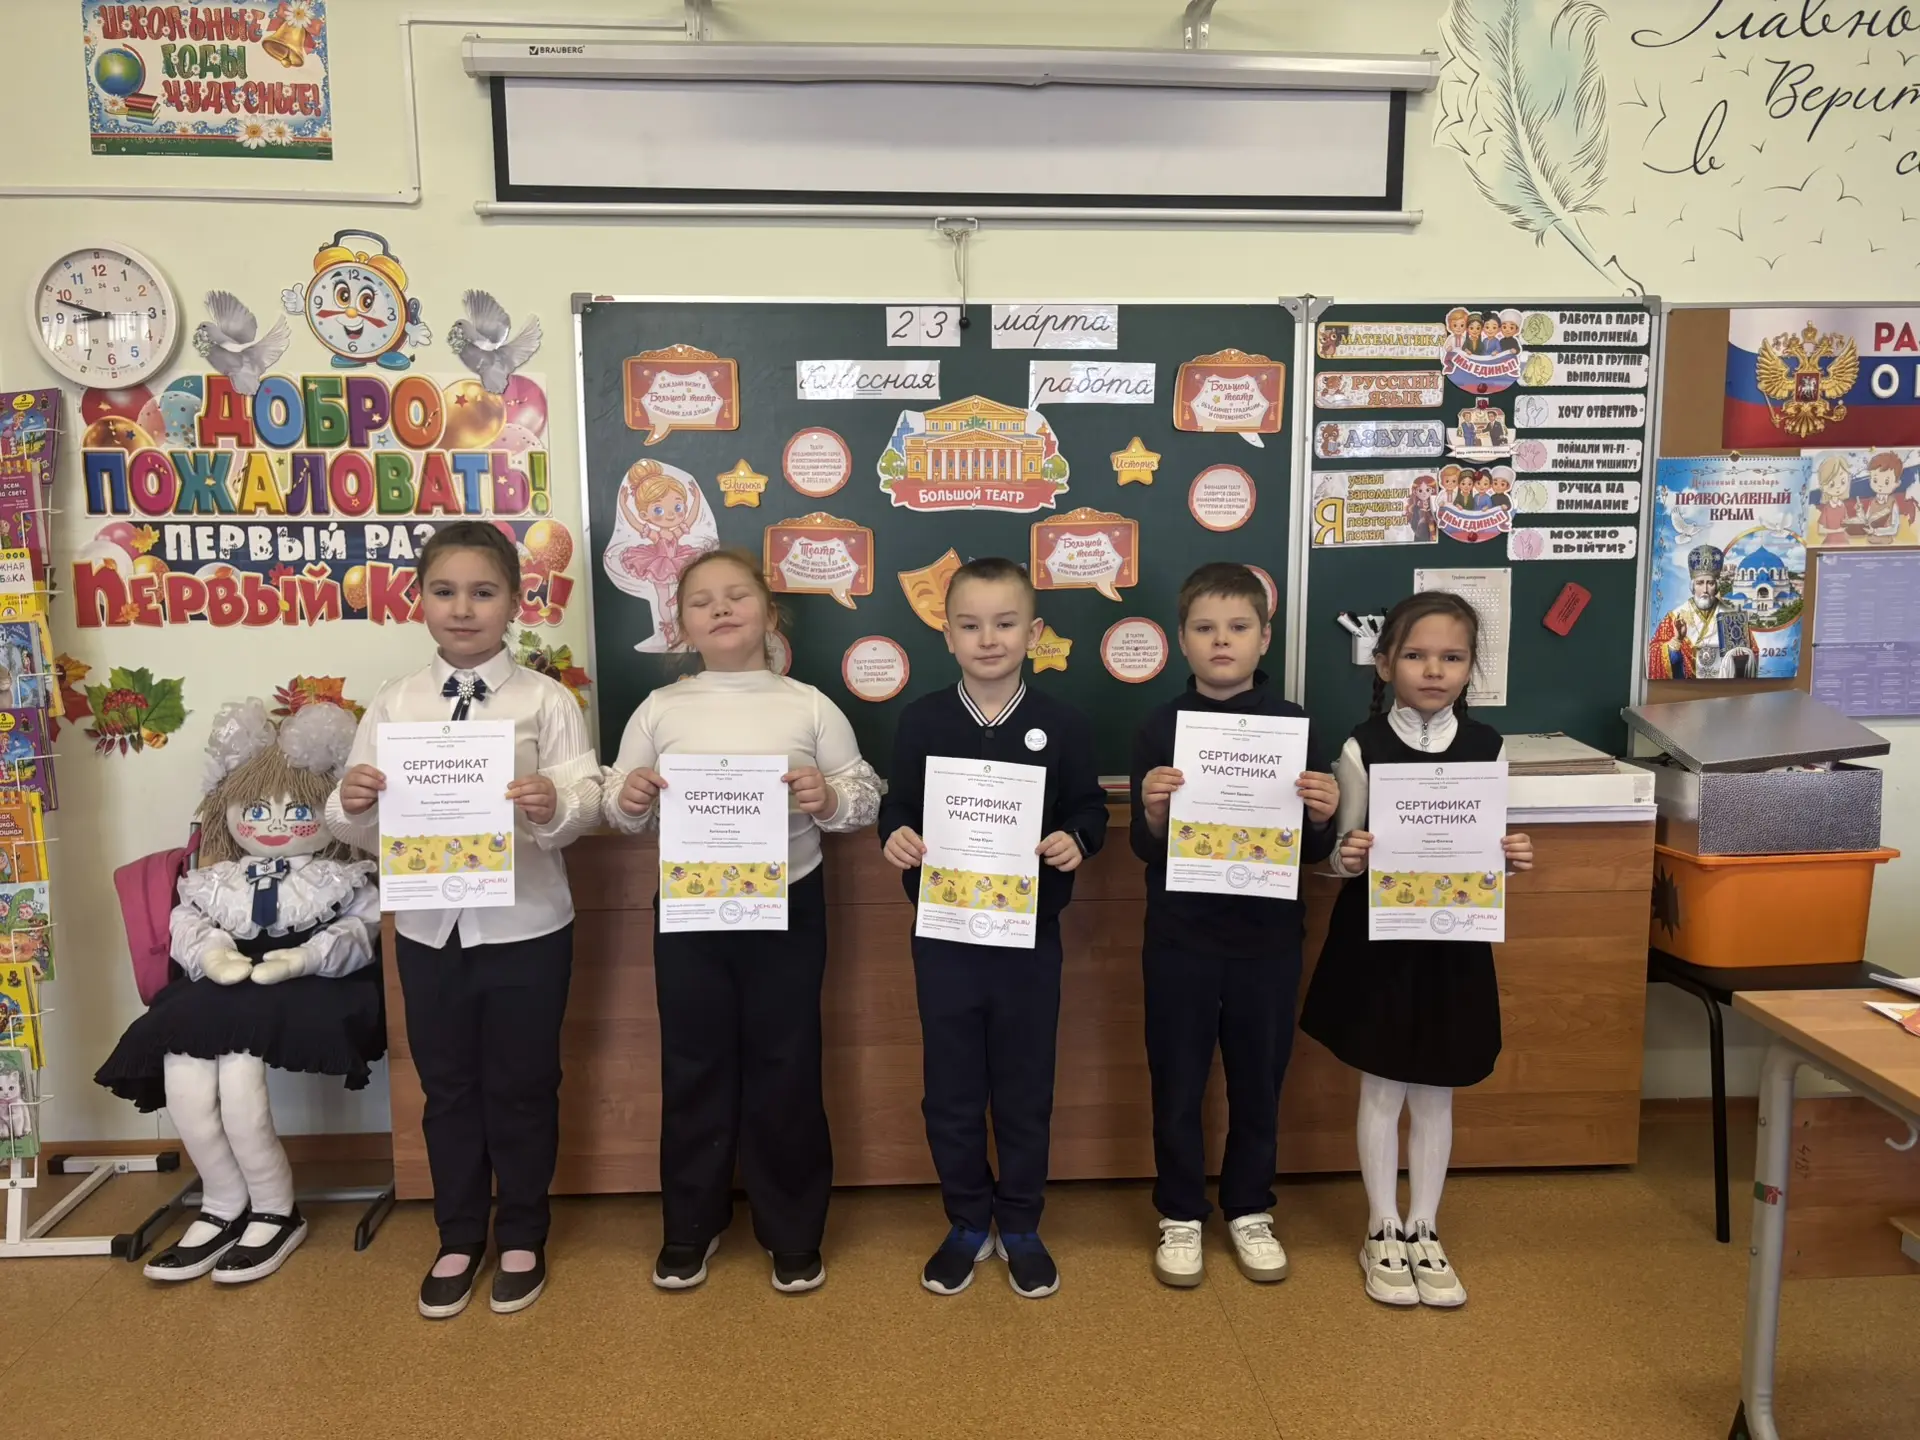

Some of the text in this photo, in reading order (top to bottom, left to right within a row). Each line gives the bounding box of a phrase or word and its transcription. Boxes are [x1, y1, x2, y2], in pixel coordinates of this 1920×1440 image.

[98, 5, 265, 42] ШКОЛЬНЫЕ
[540, 46, 584, 54] BRAUBERG
[161, 44, 247, 79] ГОДЫ
[161, 80, 322, 117] ЧУДЕСНЫЕ!
[92, 264, 107, 277] 12
[121, 269, 128, 281] 1
[348, 269, 360, 280] 12
[70, 273, 84, 285] 11
[57, 289, 72, 301] 10
[137, 285, 147, 297] 2
[314, 296, 323, 309] 9
[56, 312, 64, 324] 9
[148, 307, 157, 319] 3
[387, 308, 397, 321] 3
[1559, 313, 1645, 325] РАБОТА В ПАРЕ
[892, 310, 914, 339] 2
[926, 310, 948, 339] 3
[65, 334, 74, 346] 8
[145, 330, 153, 341] 4
[1341, 334, 1446, 346] МАТЕМАТИКА
[1563, 331, 1638, 343] ВЫПОЛНЕНА
[1874, 322, 1920, 351] РА
[131, 346, 139, 358] 5
[348, 341, 358, 353] 6
[84, 349, 92, 360] 7
[108, 353, 117, 365] 6
[1557, 353, 1643, 366] РАБОТА В ГРУППЕ
[1453, 354, 1517, 377] МЫ ЕДИНЫ!
[1351, 372, 1439, 390] РУССКИЙ
[1567, 371, 1630, 383] ВЫПОЛНЕНА
[1871, 363, 1900, 399] О
[1208, 380, 1250, 391] Большой
[648, 392, 687, 403] Большой
[1224, 393, 1254, 406] театр
[1368, 391, 1422, 405] ЯЗЫК
[200, 374, 444, 449] ДОБРО
[1558, 405, 1638, 418] ХОЧУ ОТВЕТИТЬ
[1344, 428, 1440, 448] АЗБУКА
[1557, 441, 1625, 454] ПОЙМАЛИ WI-FI
[1115, 456, 1156, 473] История
[1551, 456, 1637, 469] ПОЙМАЛИ ТИШИНУ!
[85, 450, 551, 517] ПОЖАЛОВАТЬ!
[722, 479, 762, 494] Музыка
[1348, 474, 1384, 488] узнал
[1347, 488, 1410, 501] запомнил
[1558, 483, 1624, 494] РУЧКА НА
[986, 488, 1025, 504] ТЕАТР
[1675, 489, 1791, 506] ПРАВОСЛАВНЫЙ
[1346, 501, 1404, 516] научился
[1557, 499, 1629, 510] ВНИМАНИЕ
[1314, 497, 1345, 545] Я
[1443, 513, 1463, 527] МЫ
[1710, 508, 1754, 521] КРЫМ
[1346, 515, 1409, 529] повторил
[164, 522, 436, 560] ПЕРВЫЙ РАЗ
[1346, 530, 1385, 541] понял
[1550, 530, 1619, 539] МОЖНО
[1060, 537, 1103, 549] Большой
[1552, 541, 1626, 554] ВЫЙТИ?
[1761, 647, 1787, 657] 2025
[403, 758, 489, 770] СЕРТИФИКАТ
[1199, 750, 1282, 765] СЕРТИФИКАТ
[1201, 764, 1277, 779] УЧАСТНИКА
[406, 773, 484, 785] УЧАСТНИКА
[685, 791, 764, 801] СЕРТИФИКАТ
[945, 795, 1022, 811] СЕРТИФИКАТ
[1395, 800, 1481, 810] СЕРТИФИКАТ
[688, 805, 761, 815] УЧАСТНИКА
[948, 809, 1018, 825] УЧАСТНИКА
[1399, 814, 1477, 824] УЧАСТНИКА
